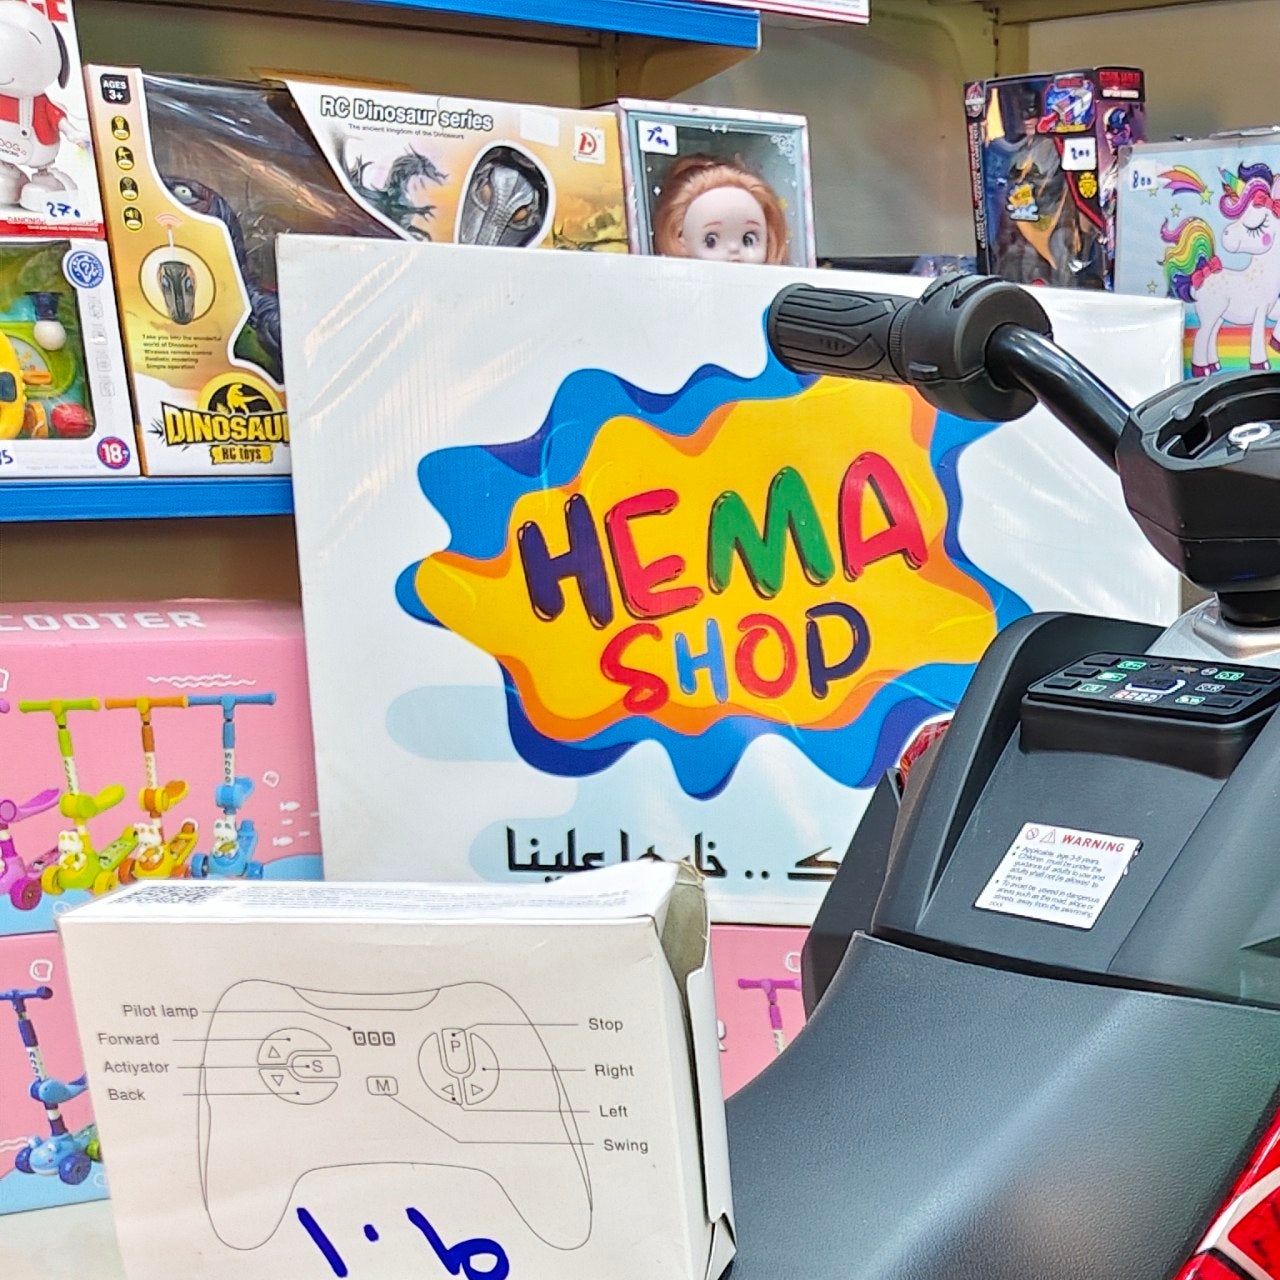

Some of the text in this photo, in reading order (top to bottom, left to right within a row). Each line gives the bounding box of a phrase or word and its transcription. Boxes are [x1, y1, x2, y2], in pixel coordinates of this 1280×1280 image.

[103, 80, 127, 90] AGES
[108, 90, 124, 100] 3+
[320, 95, 493, 131] RC Dinosaur series
[518, 451, 928, 629] HEMA
[600, 601, 871, 714] SHOP
[1061, 834, 1126, 853] WARNING
[123, 1004, 199, 1020] Pilot lamp
[589, 1018, 624, 1032] Stop
[98, 1032, 160, 1046] Forward
[451, 1040, 461, 1052] P
[312, 1060, 324, 1073] S
[594, 1064, 635, 1079] Right
[375, 1079, 391, 1092] M
[108, 1088, 146, 1101] Back
[599, 1105, 628, 1118] Left
[603, 1139, 649, 1154] Swing
